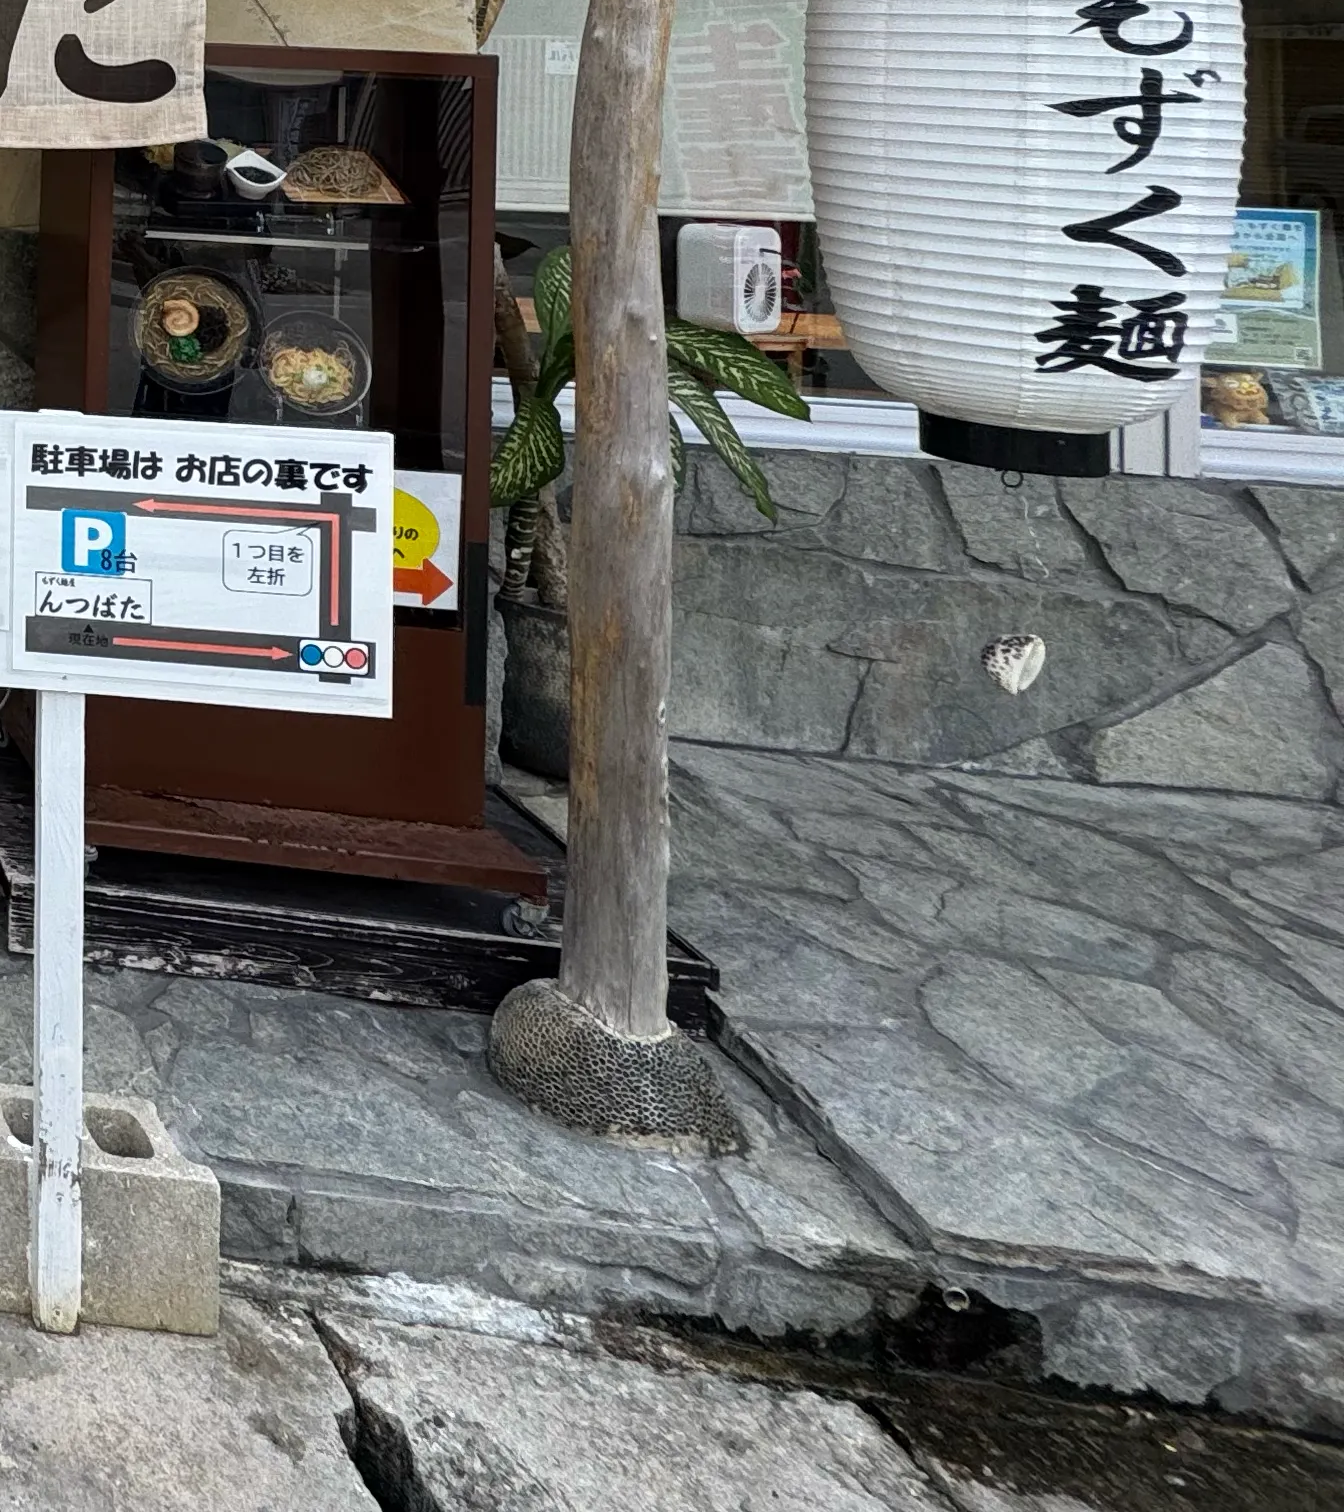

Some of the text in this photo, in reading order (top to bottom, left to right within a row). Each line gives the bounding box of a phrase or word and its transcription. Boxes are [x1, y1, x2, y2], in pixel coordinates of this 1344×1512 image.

[30, 443, 374, 493] 駐車場は お店の裏です
[73, 516, 113, 567] P
[232, 541, 306, 564] 1つ目を
[100, 549, 138, 573] 8台
[247, 566, 286, 587] 左折
[39, 590, 146, 621] んつばた
